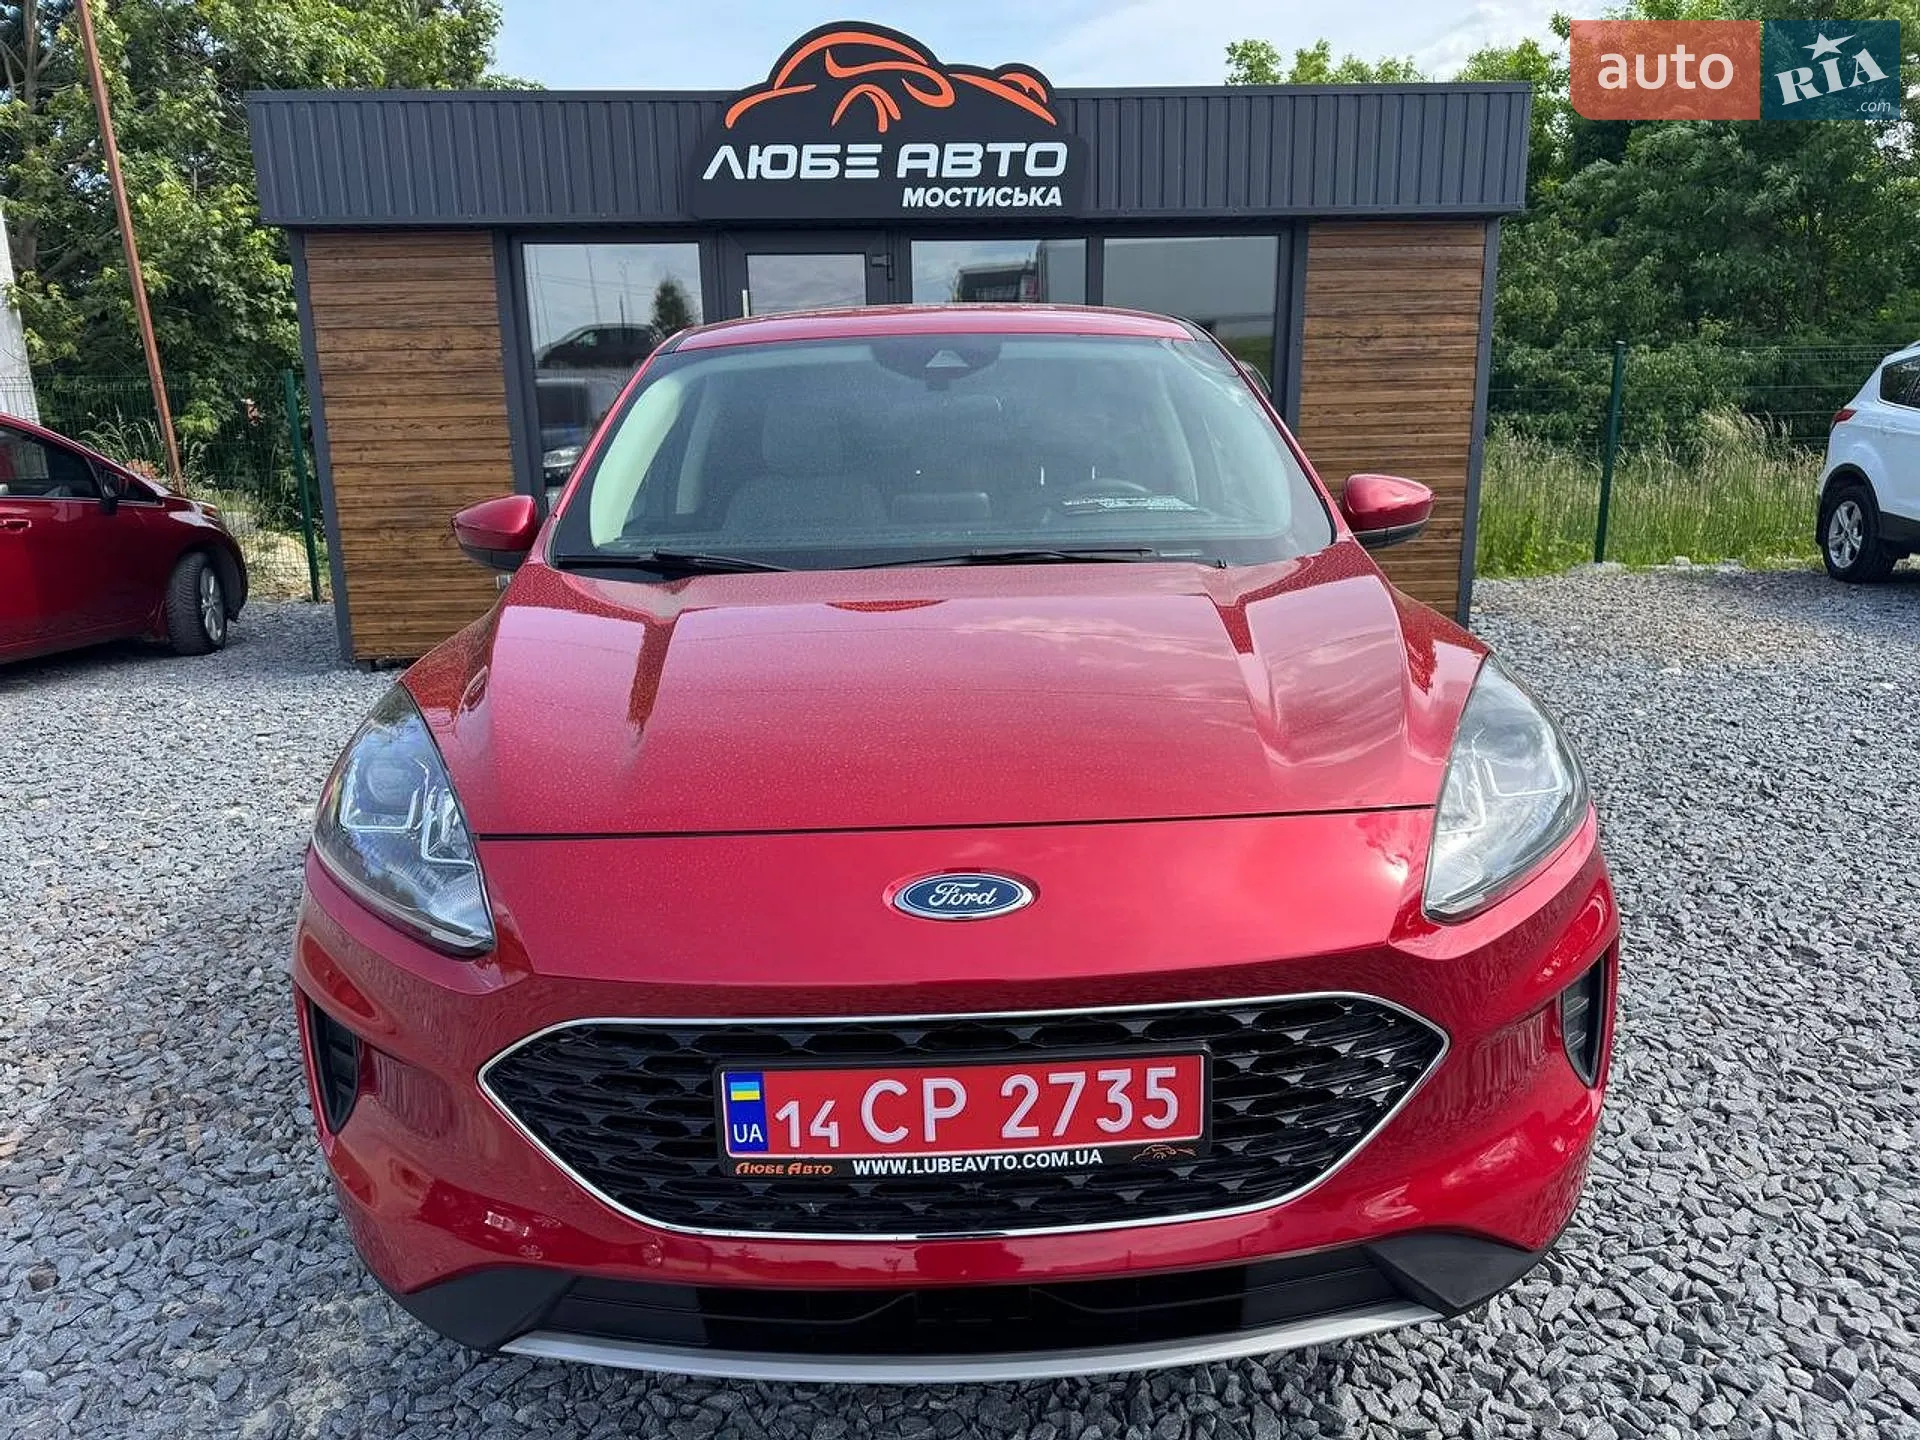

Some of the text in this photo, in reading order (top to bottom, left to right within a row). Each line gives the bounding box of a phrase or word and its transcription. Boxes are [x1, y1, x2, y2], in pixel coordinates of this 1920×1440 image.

[896, 142, 1068, 178] АВТО
[902, 186, 1063, 208] МОСТИСЬКА
[928, 881, 997, 906] Ford
[774, 1100, 840, 1149] 14
[1000, 1066, 1179, 1139] 2735
[733, 1124, 764, 1145] UA
[852, 1149, 1104, 1177] WWW.LUBEAVTO.COM.UA
